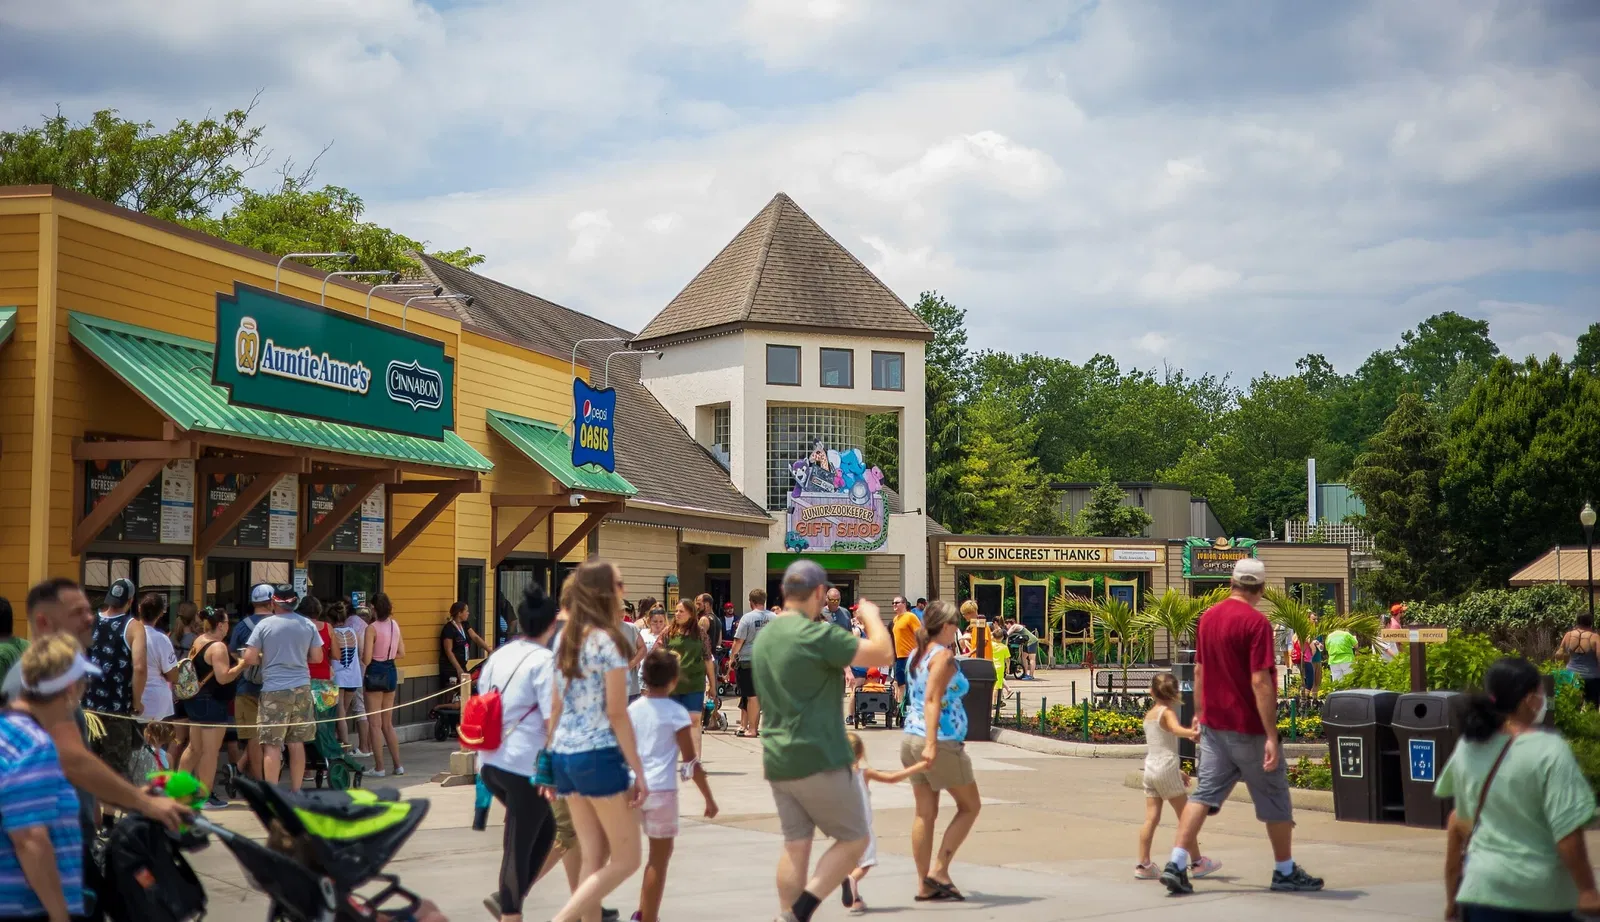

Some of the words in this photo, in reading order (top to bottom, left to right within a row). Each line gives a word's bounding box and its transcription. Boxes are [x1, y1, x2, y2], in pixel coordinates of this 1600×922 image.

[391, 370, 439, 399] CINNABON
[591, 408, 608, 423] pepsi
[580, 423, 609, 452] OASIS
[802, 505, 831, 520] JUNIOR
[831, 505, 874, 522] ZOOKEEPER
[796, 522, 832, 537] GIFT
[837, 523, 881, 538] SHOP
[958, 548, 984, 559] OUR
[988, 548, 1050, 560] SINCEREST
[1054, 549, 1100, 561] THANKS
